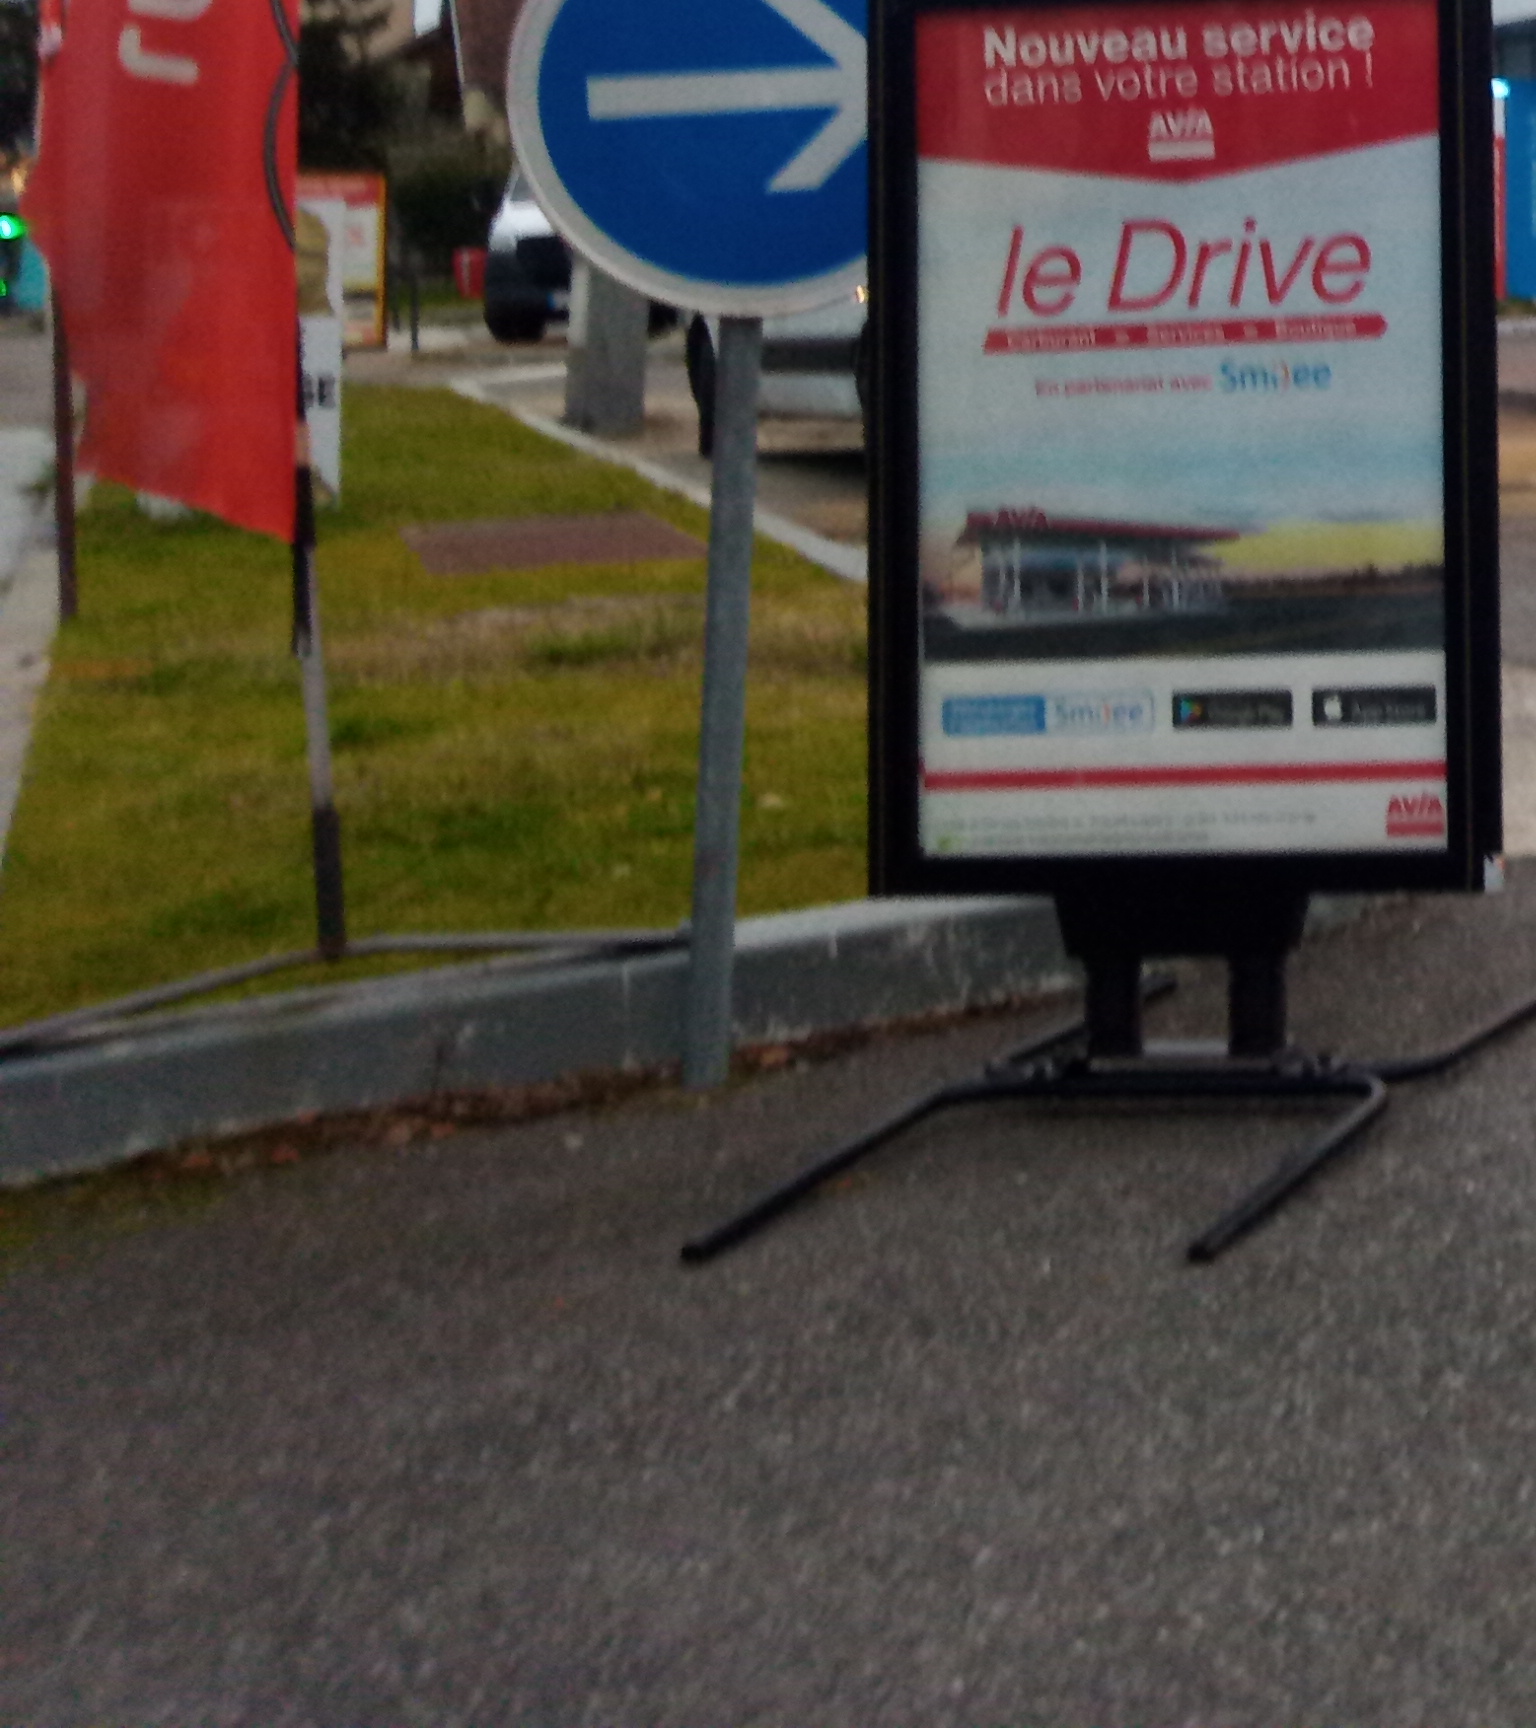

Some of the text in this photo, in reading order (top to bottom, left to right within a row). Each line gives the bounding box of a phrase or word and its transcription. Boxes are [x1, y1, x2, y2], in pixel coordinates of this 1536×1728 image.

[983, 8, 1375, 69] Nouveau service
[984, 65, 1083, 106] dans
[1095, 61, 1199, 101] votre
[1213, 54, 1350, 97] station
[996, 215, 1373, 319] le Drive
